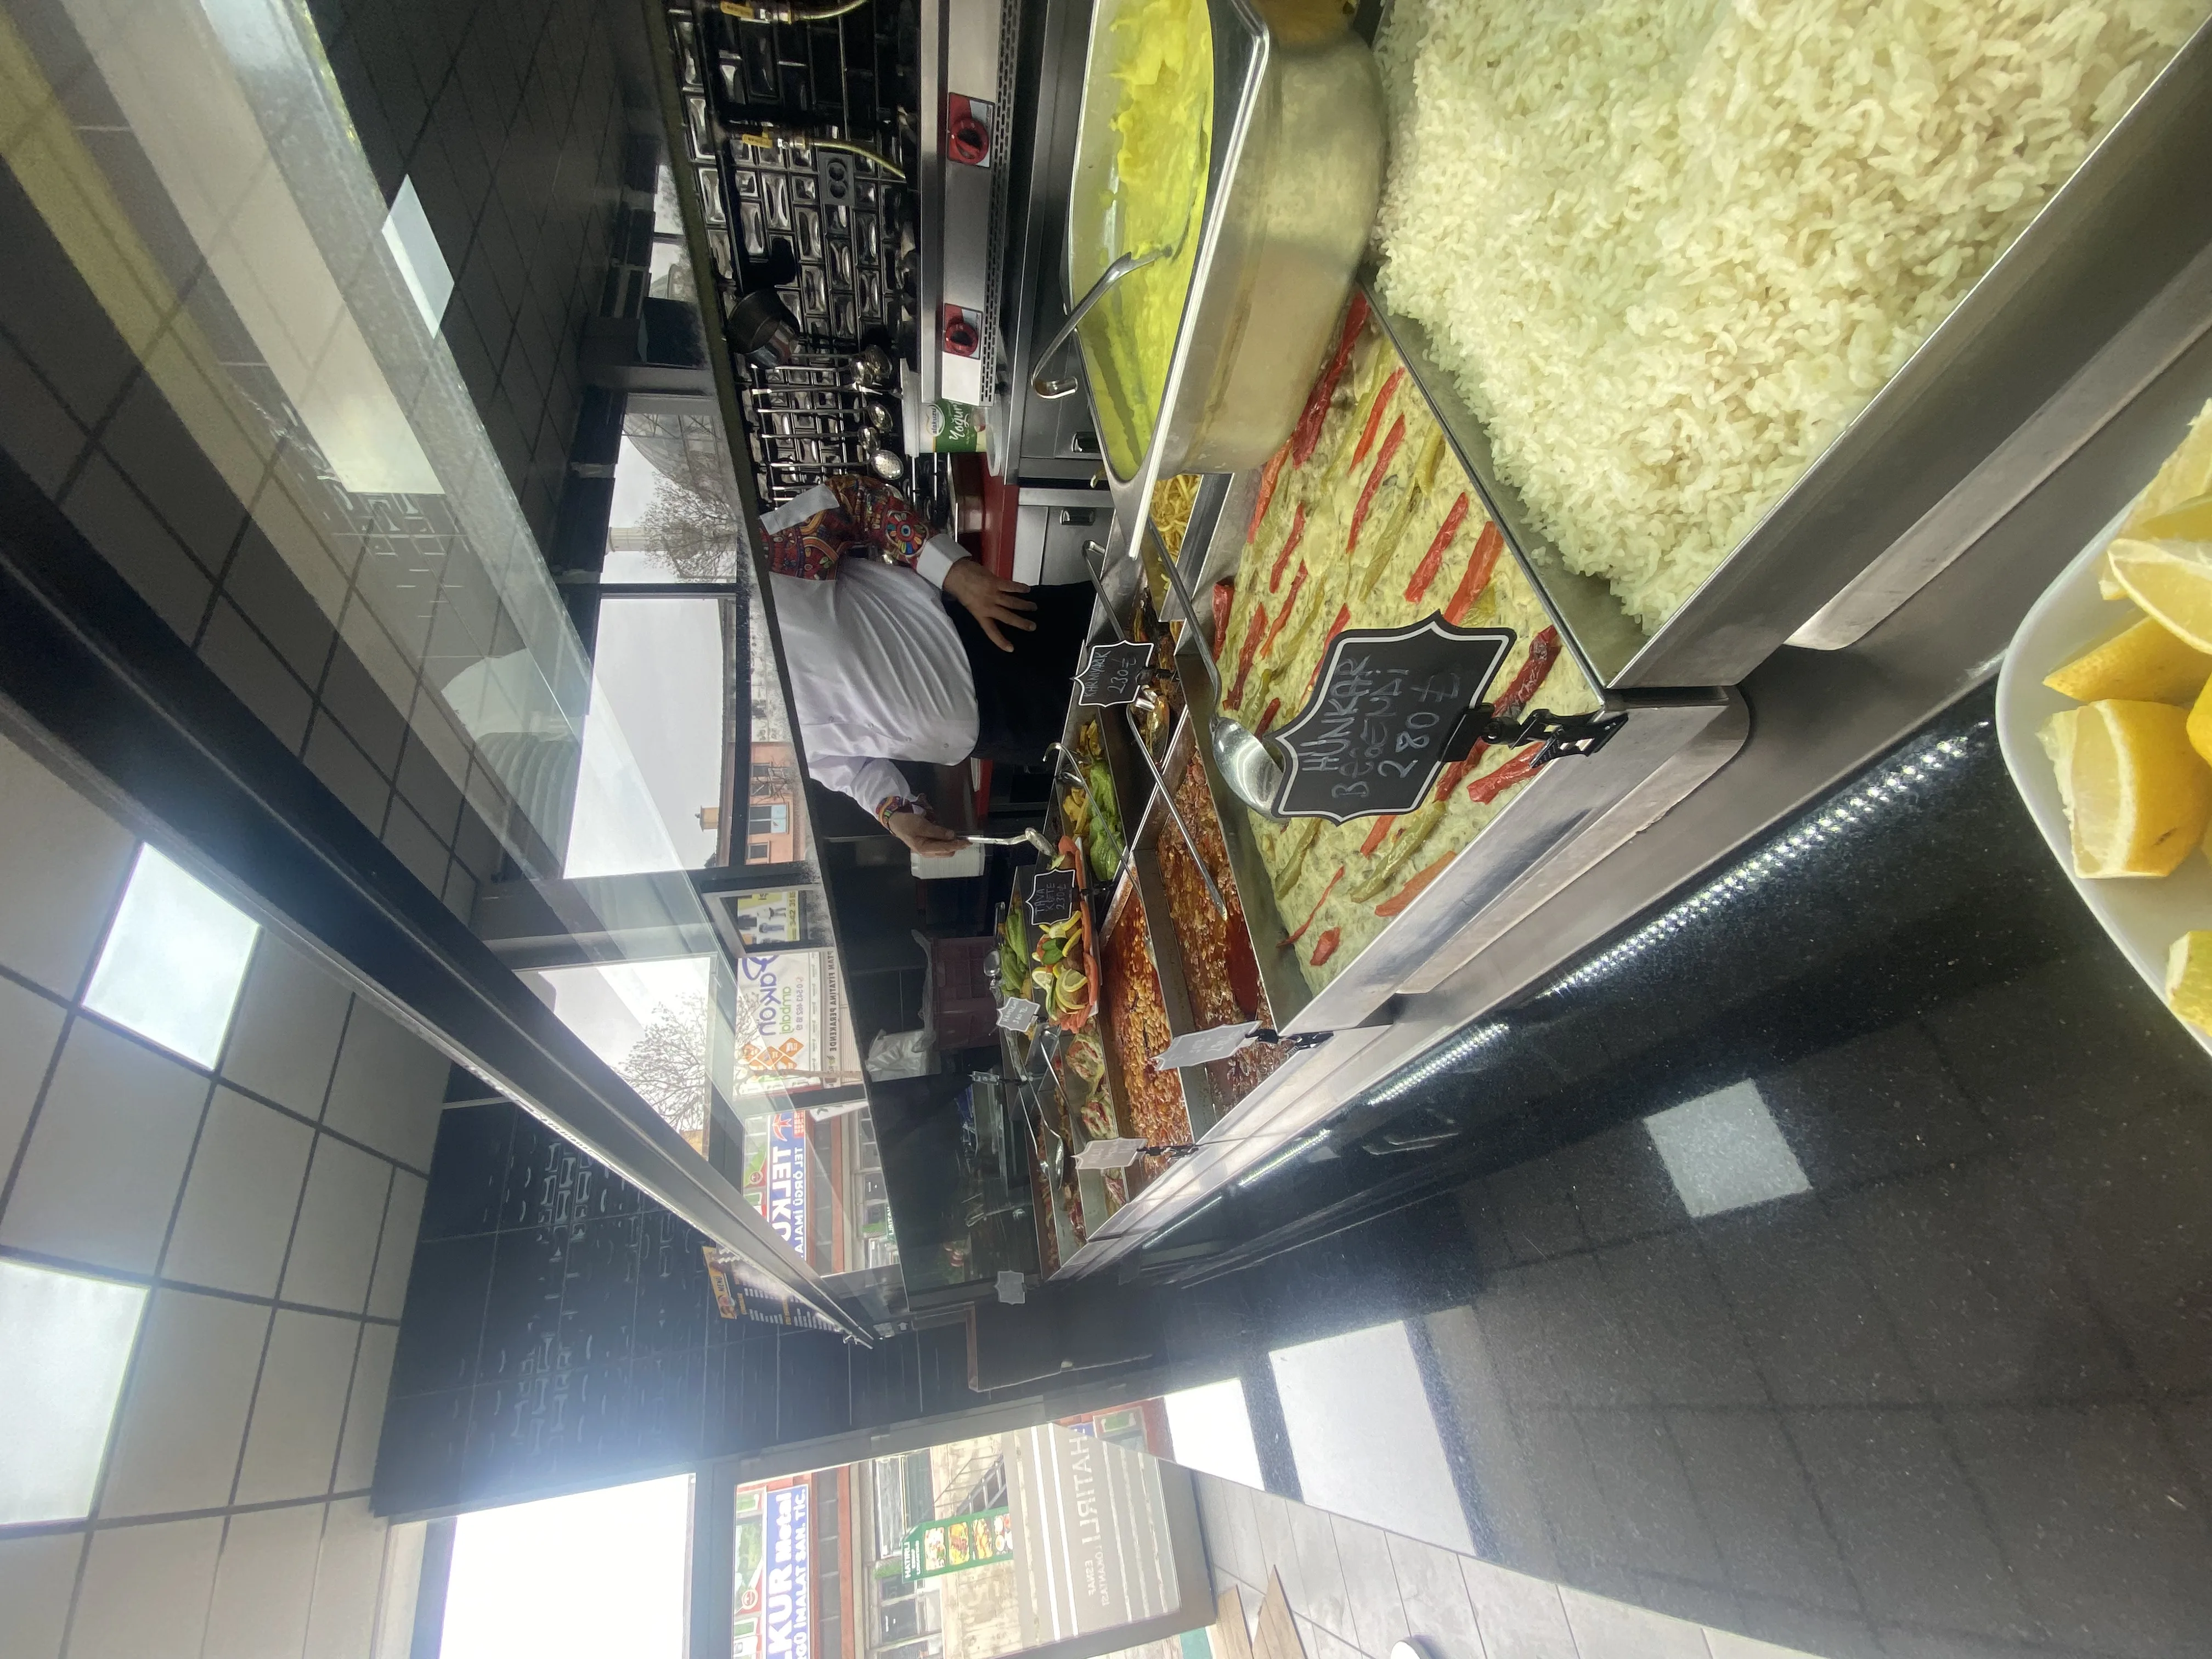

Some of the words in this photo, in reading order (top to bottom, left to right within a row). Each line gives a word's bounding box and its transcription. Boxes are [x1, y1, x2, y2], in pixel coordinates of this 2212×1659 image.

[1107, 669, 1129, 693] 230
[1378, 712, 1440, 778] 280
[1034, 888, 1045, 915] TAVA
[1056, 892, 1065, 910] 230
[793, 1488, 806, 1521] TİC.
[775, 1492, 792, 1563] Metal
[794, 1522, 807, 1562] SAN.
[768, 1564, 793, 1659] KUR
[793, 1565, 807, 1628] İMALAT
